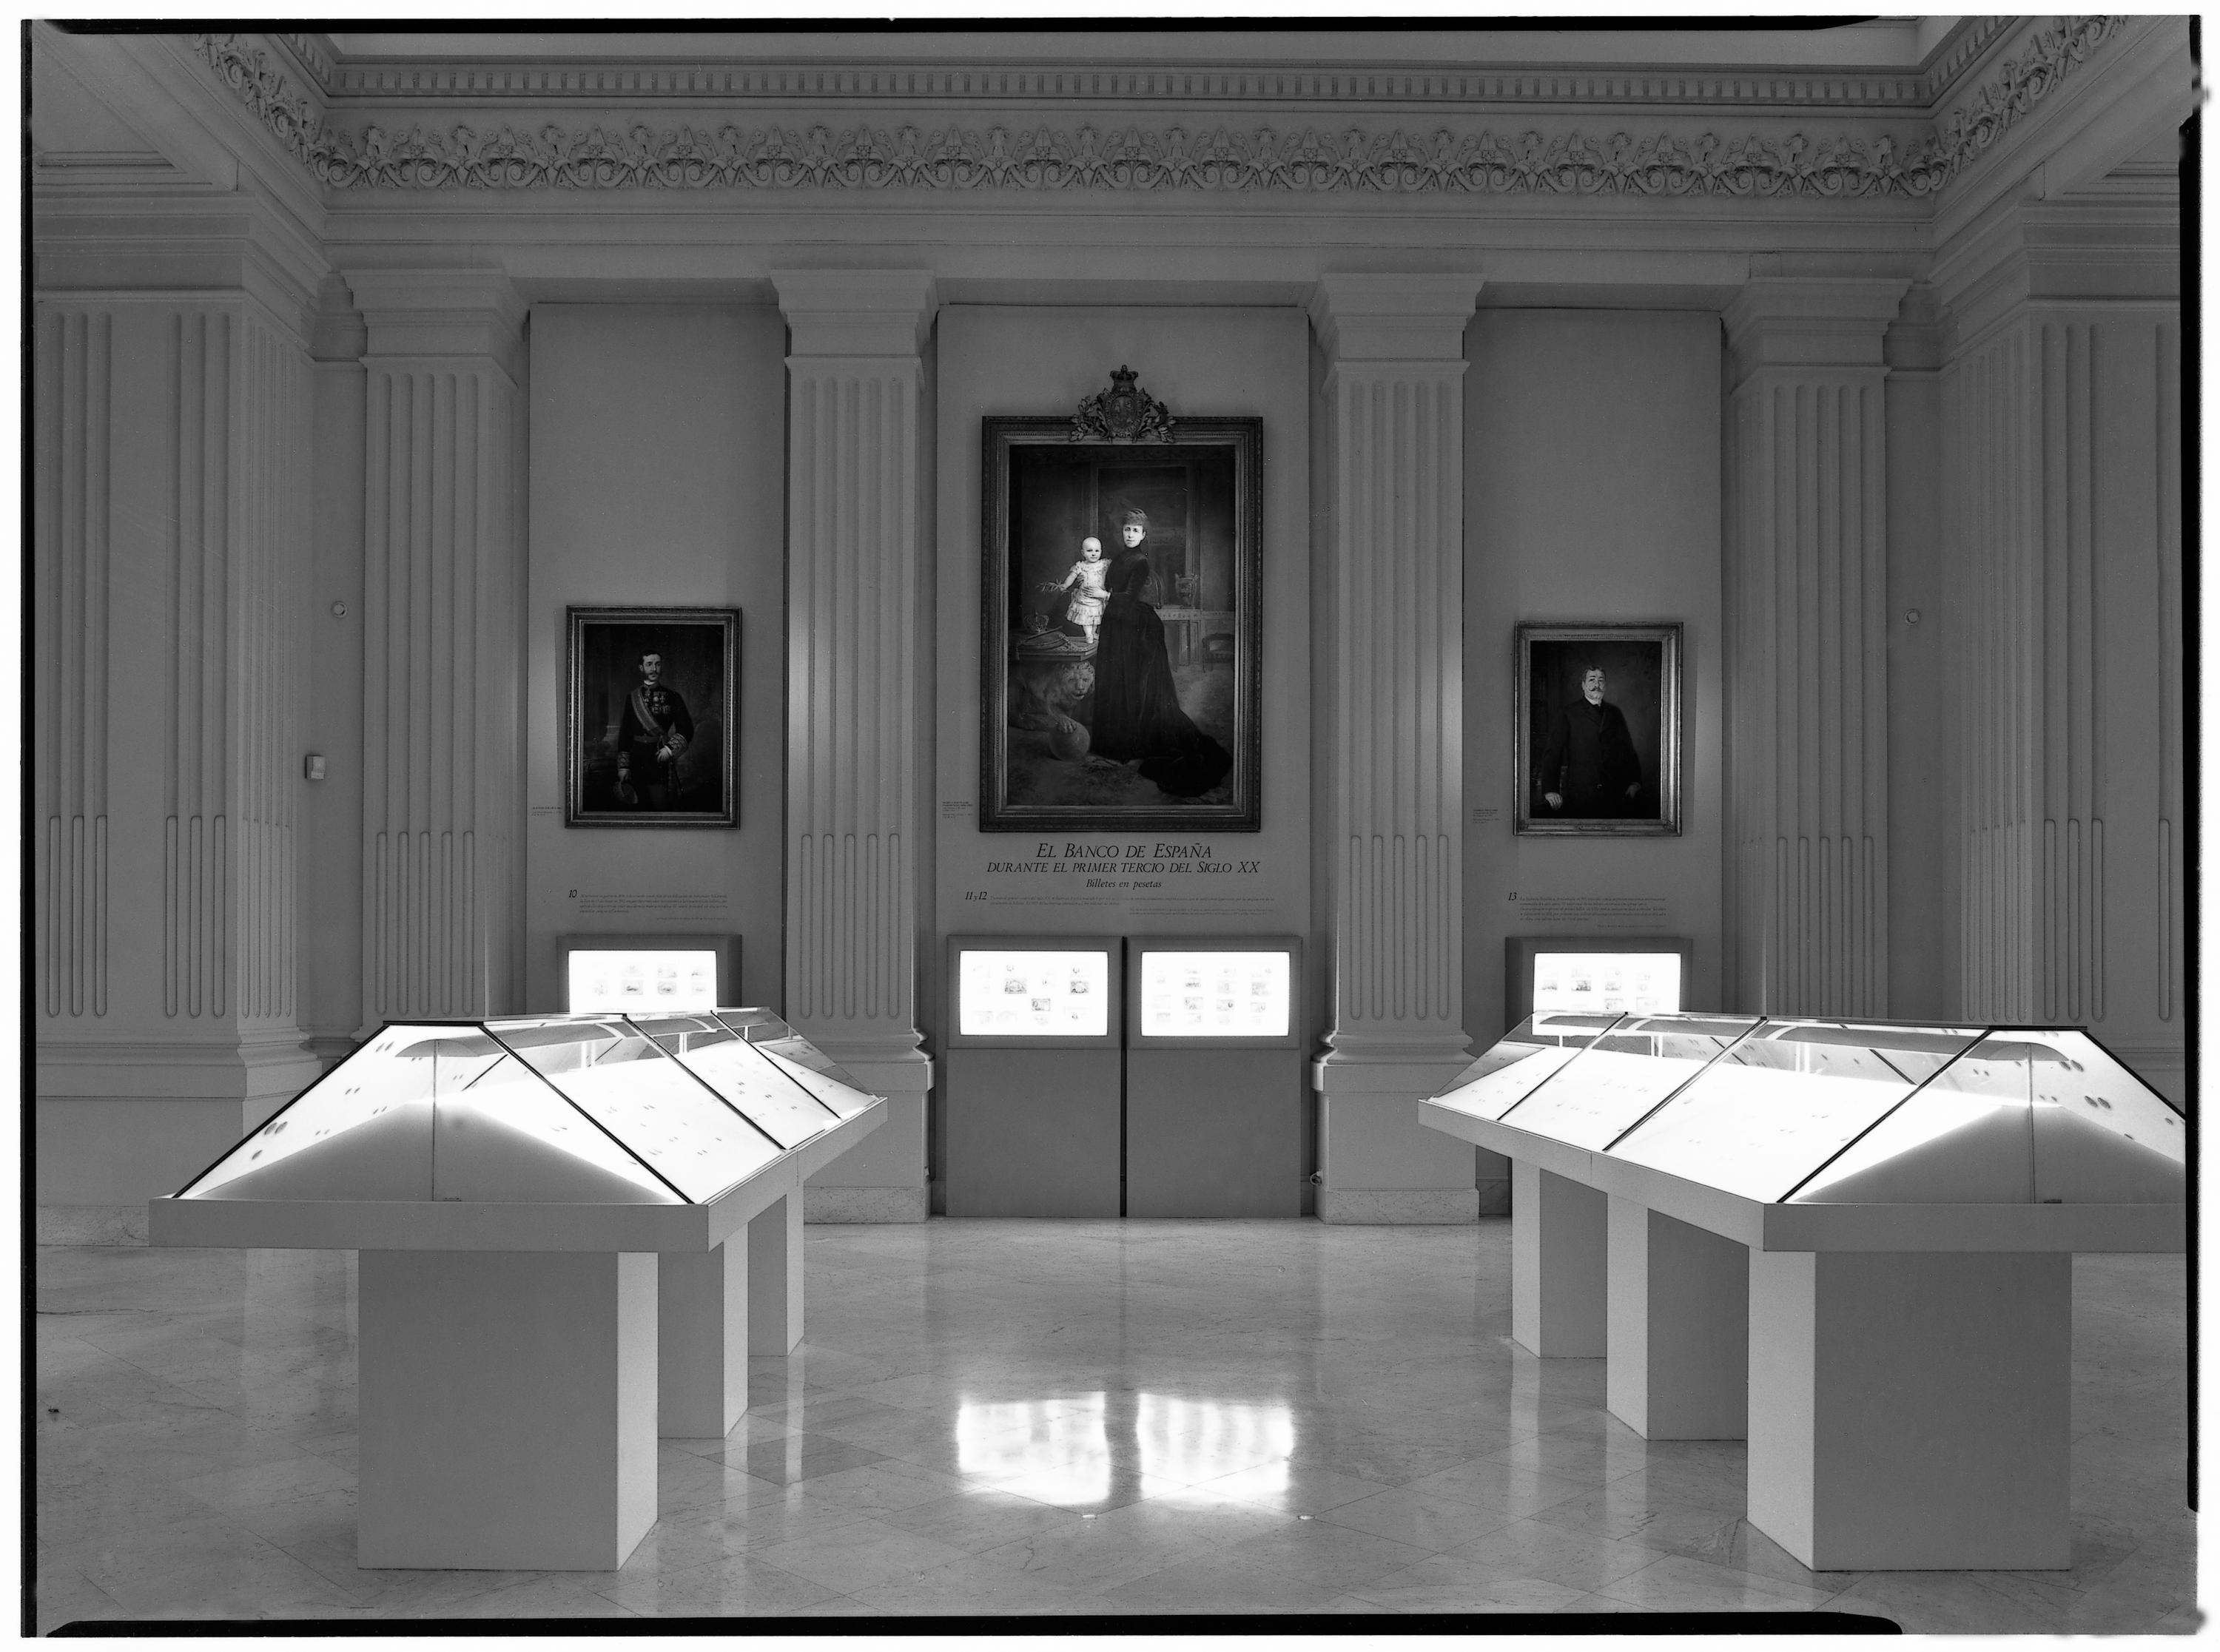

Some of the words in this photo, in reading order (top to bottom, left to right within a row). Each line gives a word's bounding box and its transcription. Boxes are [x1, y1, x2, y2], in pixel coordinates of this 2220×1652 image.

[1035, 843, 1057, 858] EL
[1063, 843, 1120, 858] BANCO
[1125, 845, 1146, 858] DE
[1152, 843, 1212, 858] ESPAÑA
[986, 862, 1049, 873] DURANTE
[1052, 862, 1068, 873] EL
[1072, 862, 1117, 873] PRIMER
[1120, 862, 1165, 873] TERCIO
[1168, 863, 1192, 873] DEL
[1197, 860, 1232, 874] SIGLO
[1236, 860, 1261, 874] XX
[1086, 877, 1116, 889] Billetes
[1132, 880, 1162, 891] pesetas
[568, 889, 578, 899] 10
[1507, 891, 1518, 901] 13
